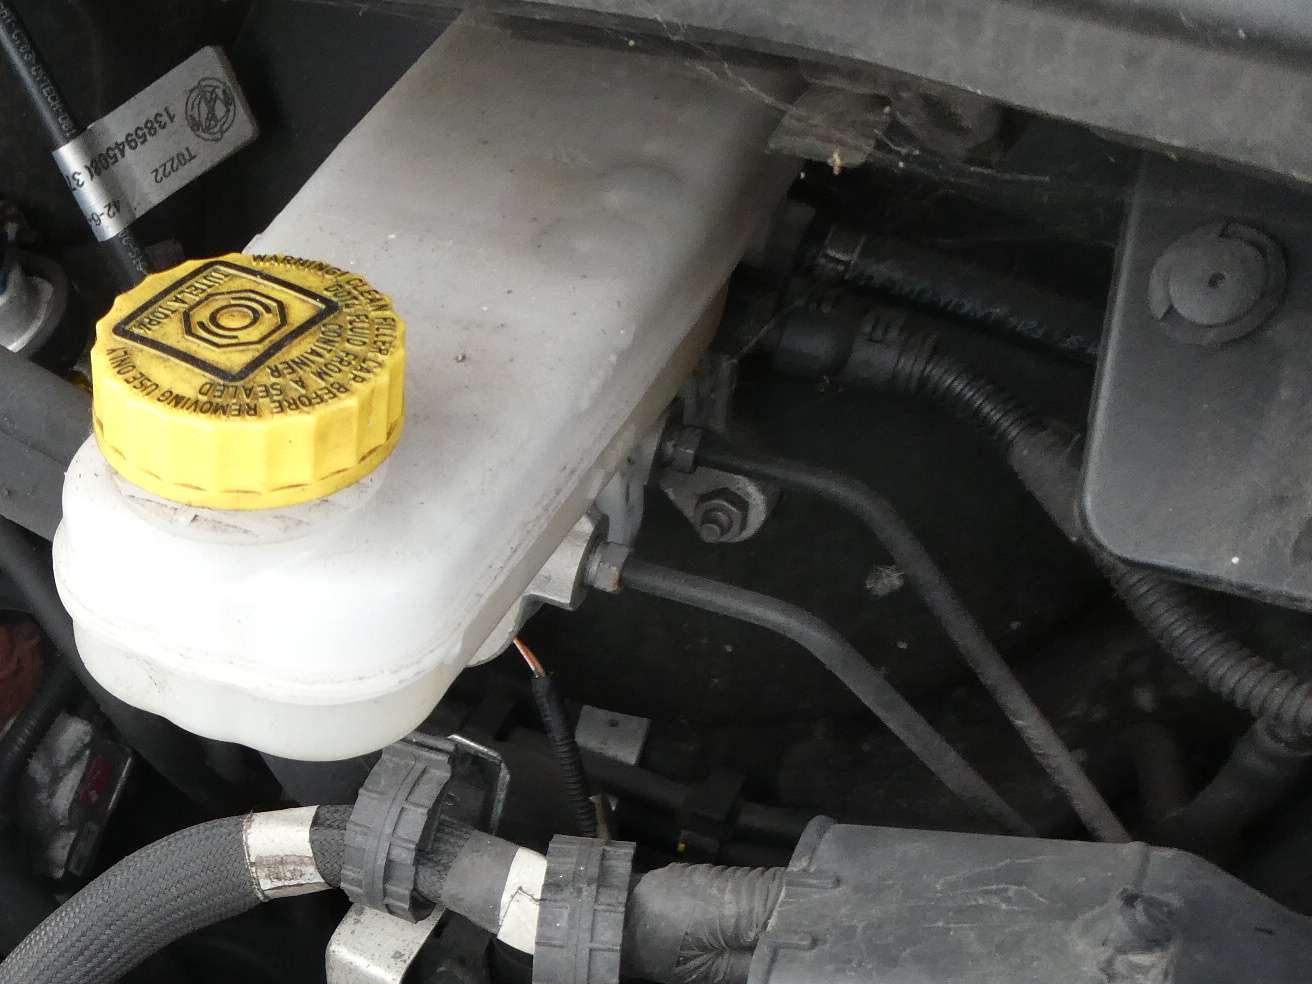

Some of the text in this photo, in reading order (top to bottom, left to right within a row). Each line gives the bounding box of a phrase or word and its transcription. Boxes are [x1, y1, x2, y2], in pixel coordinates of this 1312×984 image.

[151, 146, 196, 184] T0222
[171, 270, 231, 306] TUTELA
[346, 277, 389, 312] CLEAN
[346, 314, 369, 347] FLUID
[374, 317, 397, 355] FILLER
[106, 347, 136, 375] ONLY
[266, 323, 343, 379] CONTAINER
[311, 351, 357, 382] FROM
[124, 373, 159, 396] USE
[199, 381, 283, 399] SEALED
[273, 381, 350, 414] BEFORE
[157, 390, 258, 417] REMOVING
